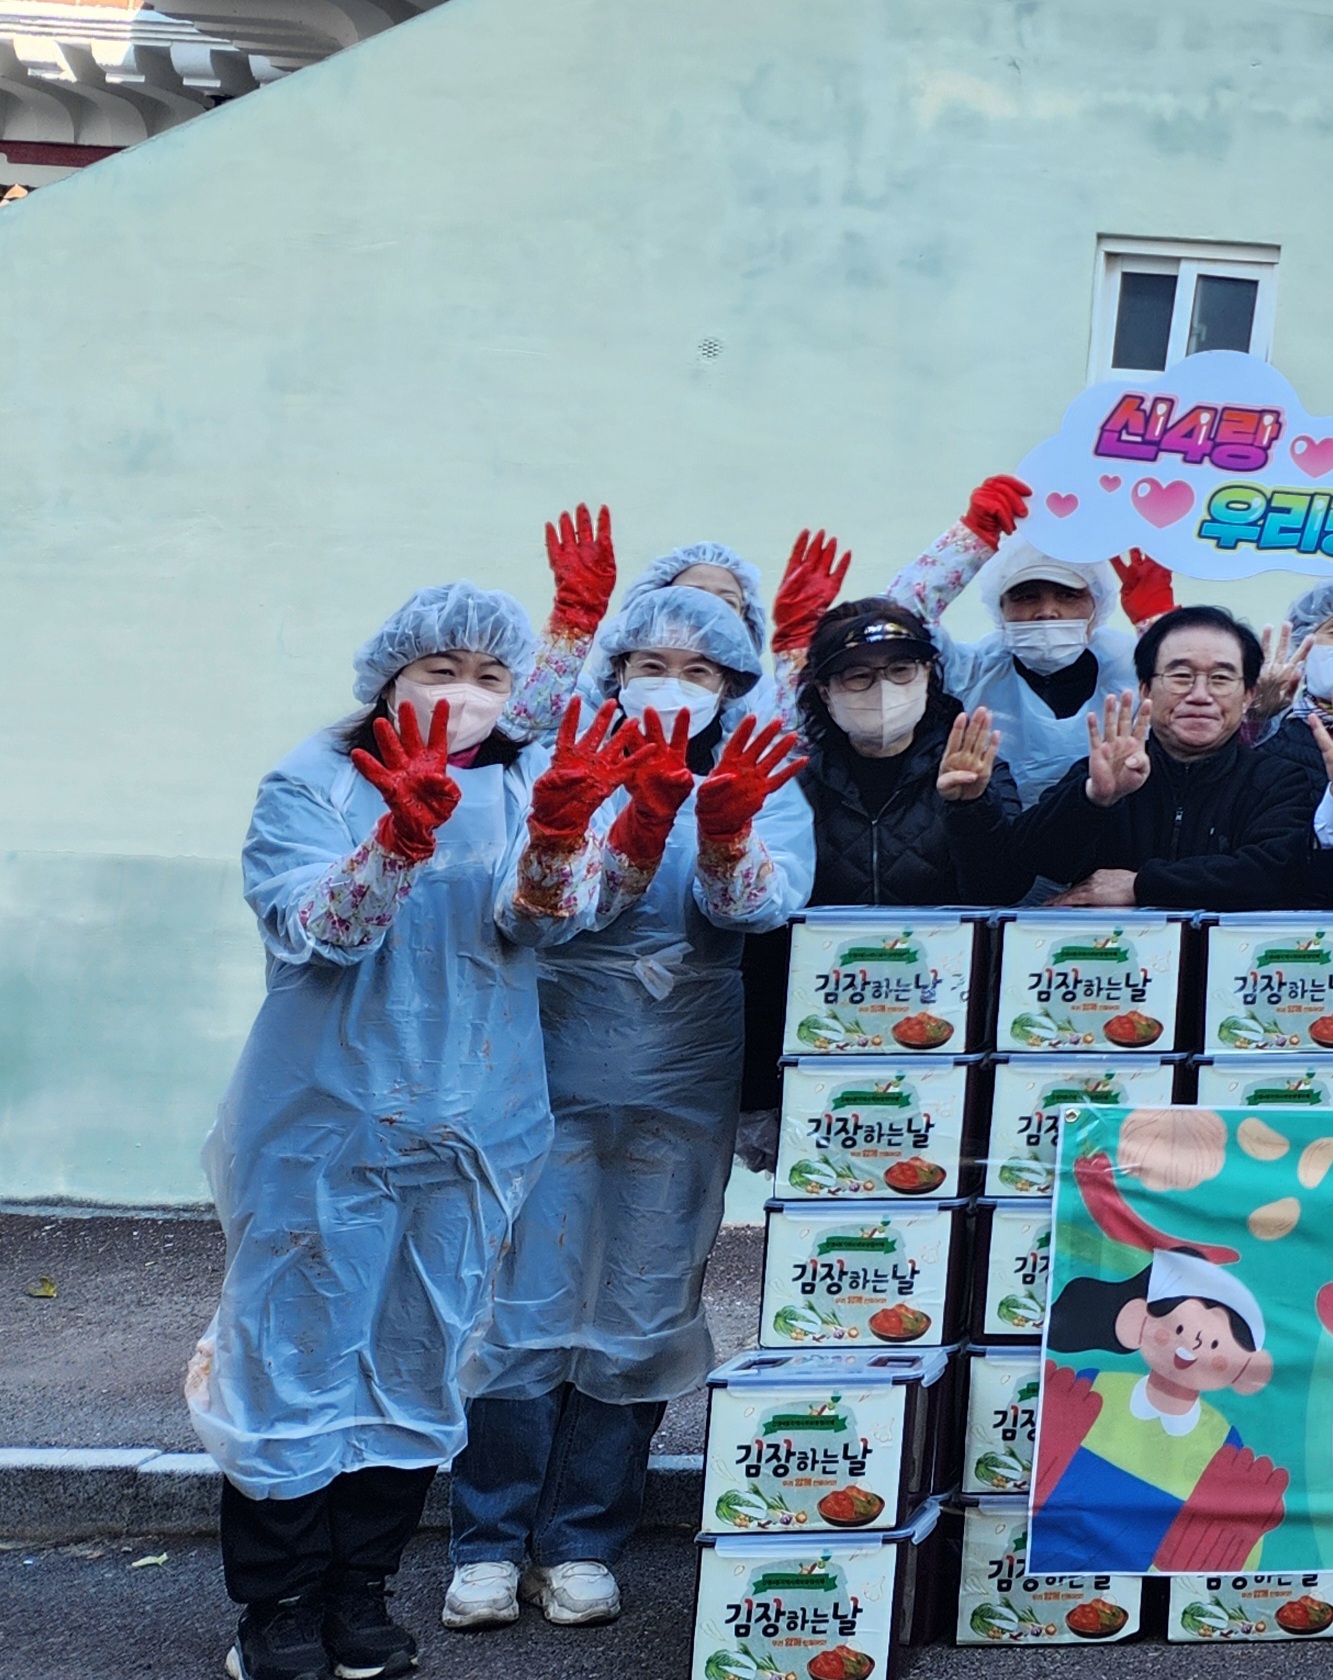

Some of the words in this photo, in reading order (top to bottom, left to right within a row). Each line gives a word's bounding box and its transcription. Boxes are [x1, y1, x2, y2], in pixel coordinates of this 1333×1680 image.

[1094, 393, 1285, 472] 신4랑
[1028, 968, 1151, 1003] 김장하는날
[807, 1113, 935, 1149] 김장하는날
[792, 1259, 920, 1295] 김장하는날
[736, 1438, 873, 1478] 김장하는날
[725, 1597, 863, 1637] 김장하는날
